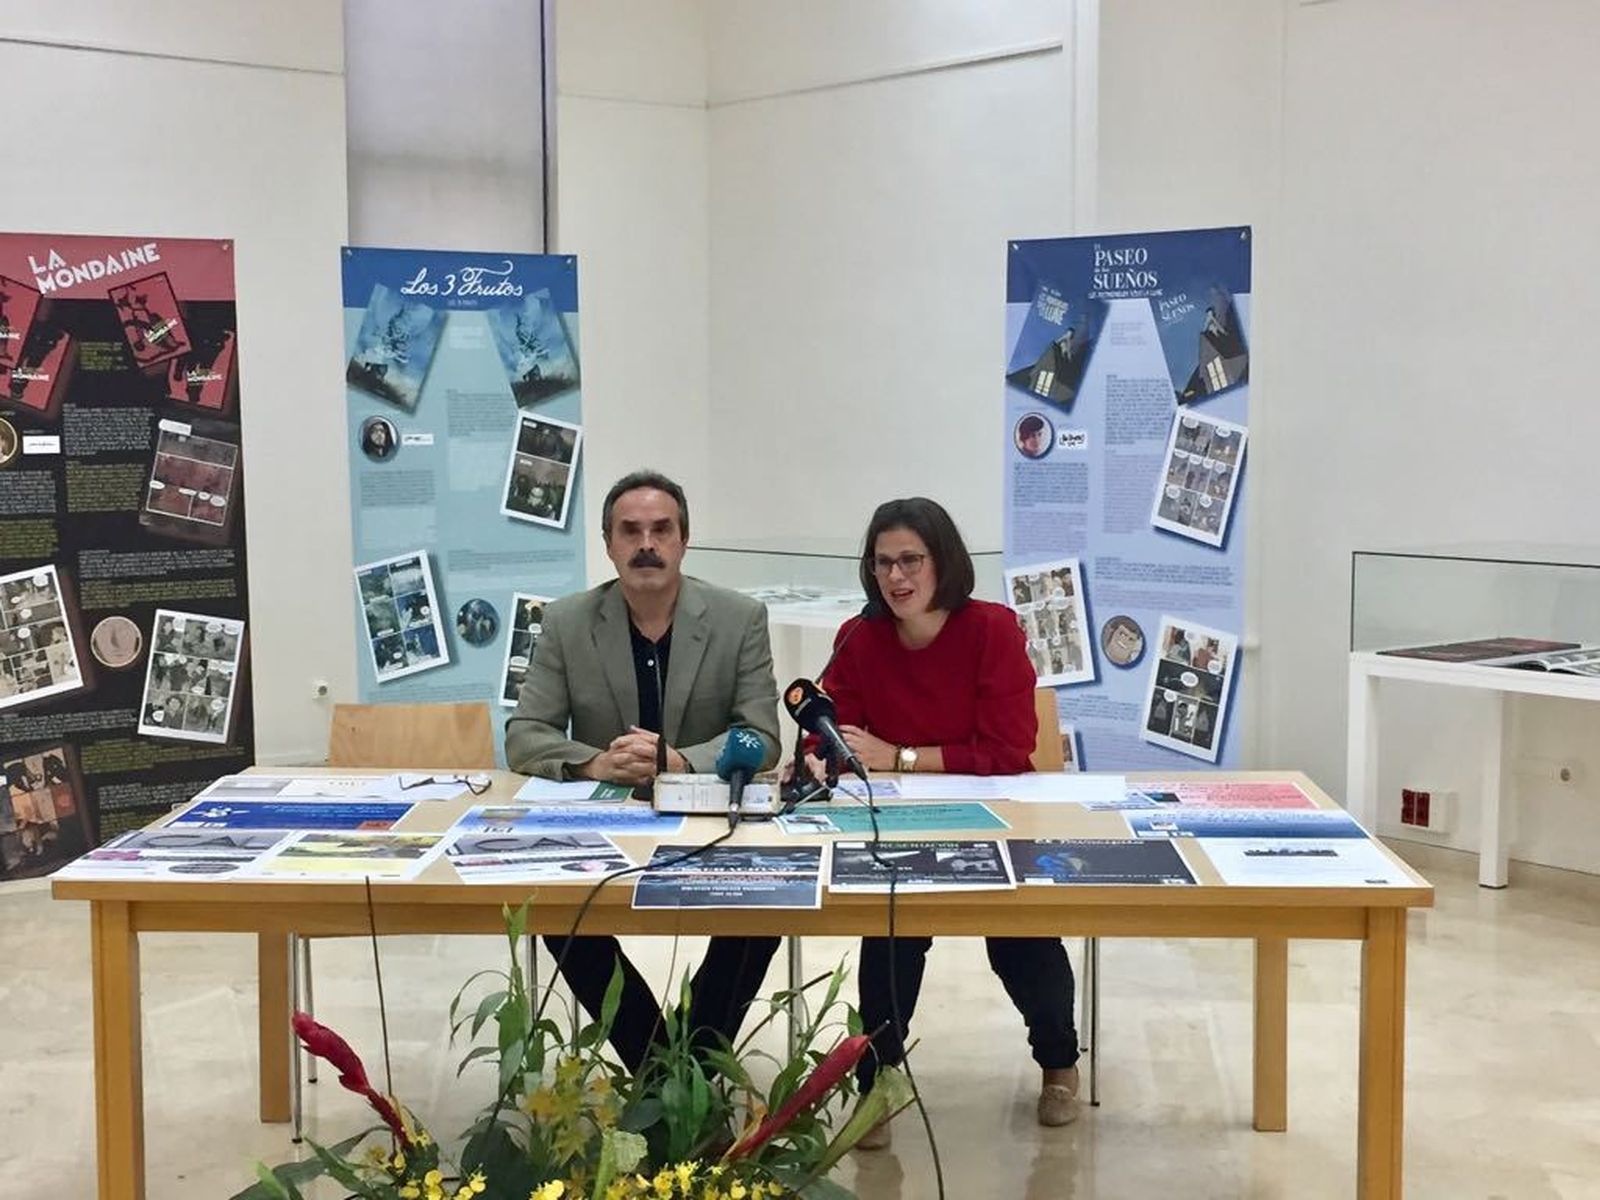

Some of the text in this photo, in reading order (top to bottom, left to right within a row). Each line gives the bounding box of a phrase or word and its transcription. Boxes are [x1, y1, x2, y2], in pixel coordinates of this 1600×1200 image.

[28, 249, 66, 274] LA
[35, 243, 161, 294] MONDAINE
[1094, 247, 1148, 267] PASEO
[400, 260, 523, 297] Los 3 Frutos
[1093, 268, 1158, 290] SUEÑOS
